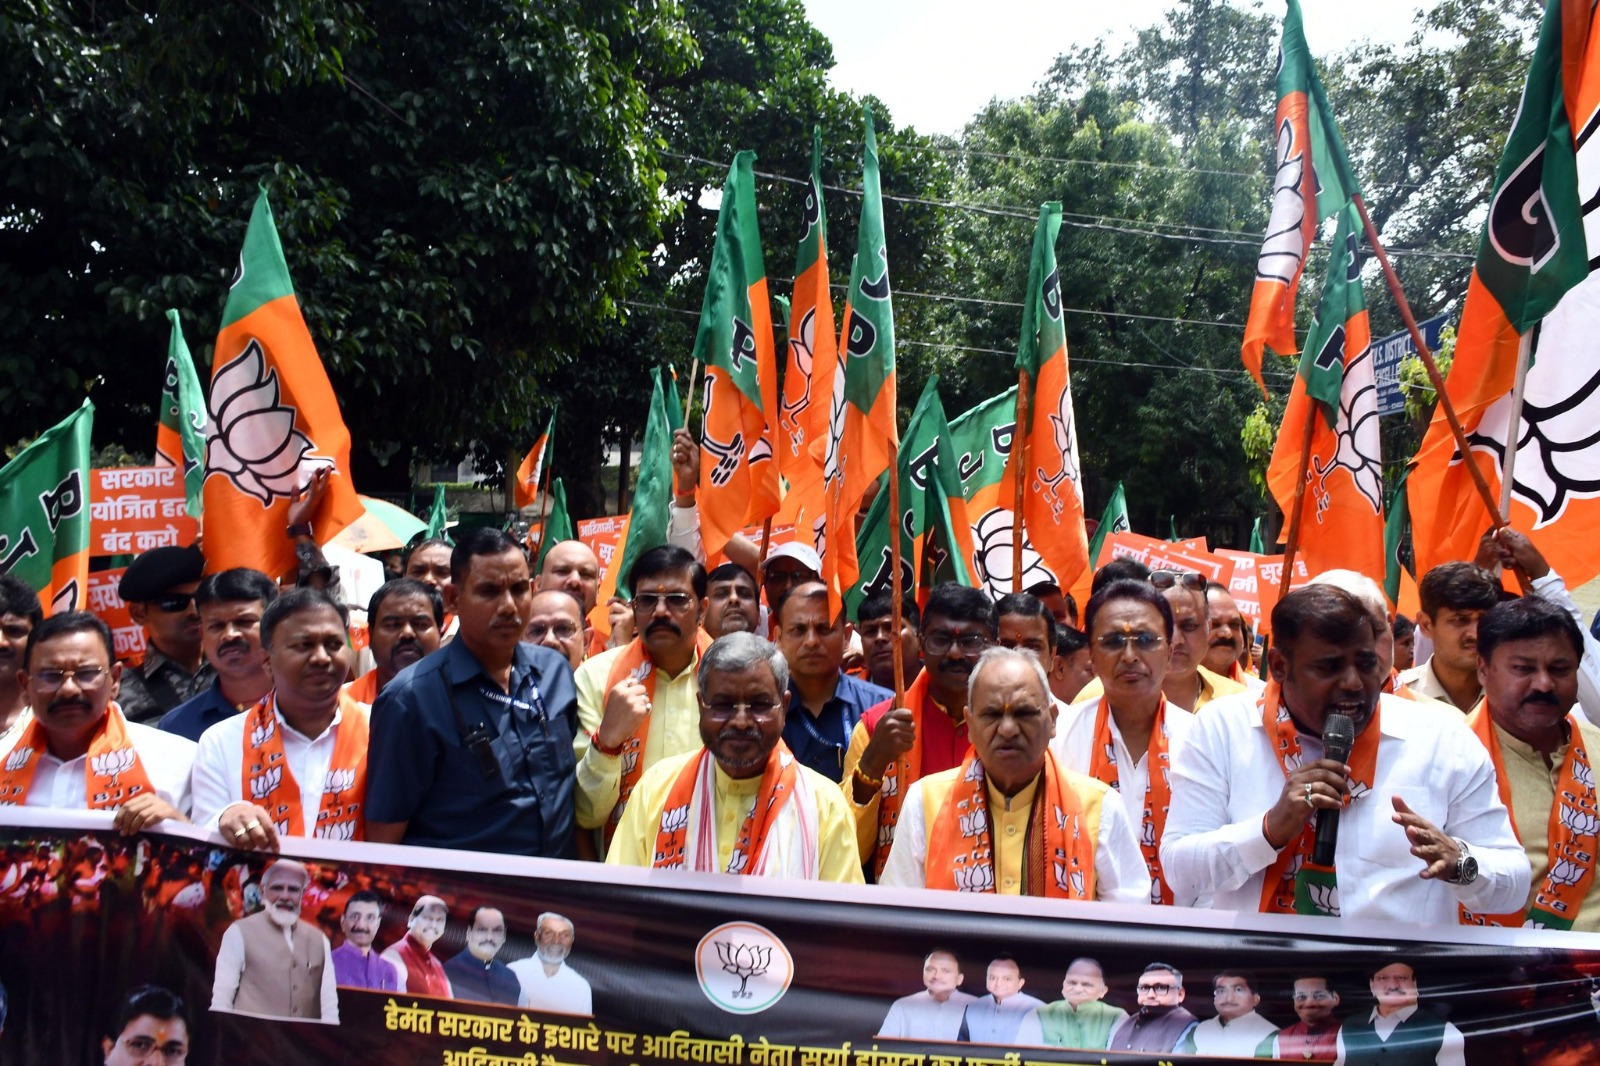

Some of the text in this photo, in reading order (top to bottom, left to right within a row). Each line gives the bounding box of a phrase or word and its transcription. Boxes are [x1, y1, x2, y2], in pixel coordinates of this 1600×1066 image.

[98, 467, 176, 490] सरकार
[90, 494, 157, 522] योजित
[101, 523, 179, 552] बंद करो
[93, 784, 143, 804] BJP
[316, 802, 361, 822] BJP
[384, 998, 434, 1035] हेमंत
[437, 1009, 514, 1043] सरकार
[516, 1014, 541, 1044] के
[543, 1022, 602, 1052] इशारे
[605, 1031, 636, 1055] पर
[642, 1029, 744, 1066] आदिवासी
[748, 1035, 796, 1066] नेता
